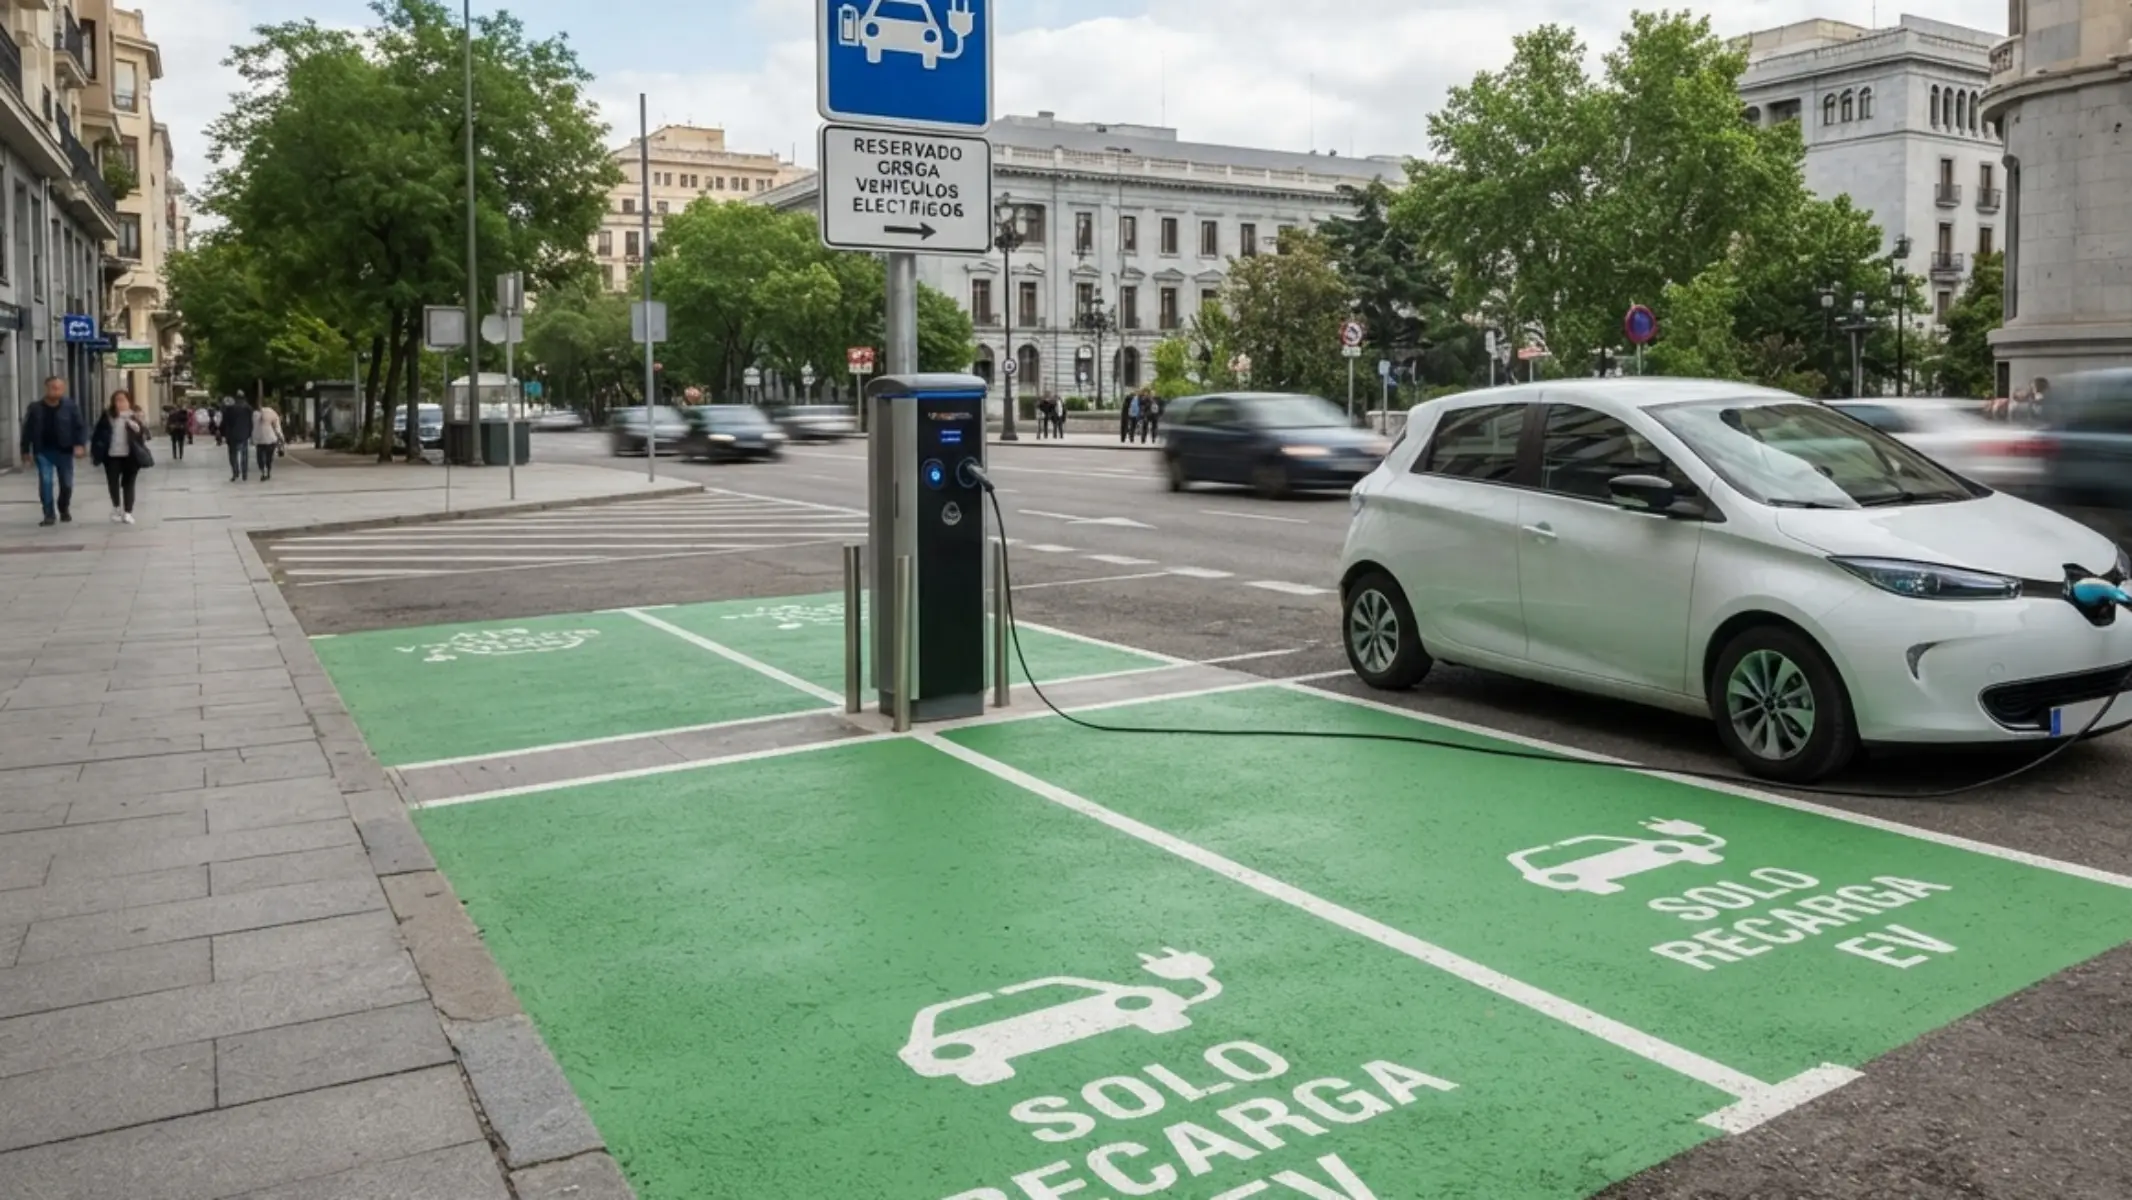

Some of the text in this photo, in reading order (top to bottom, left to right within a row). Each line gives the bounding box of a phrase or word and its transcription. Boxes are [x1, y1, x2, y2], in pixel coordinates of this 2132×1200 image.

[854, 137, 963, 161] RESERVADO
[1647, 866, 1821, 922] SOLO
[1649, 875, 1954, 972] RECARGA
[1834, 923, 1958, 970] EV
[1008, 1039, 1291, 1142] SOLO
[938, 1058, 1463, 1200] ECARGA
